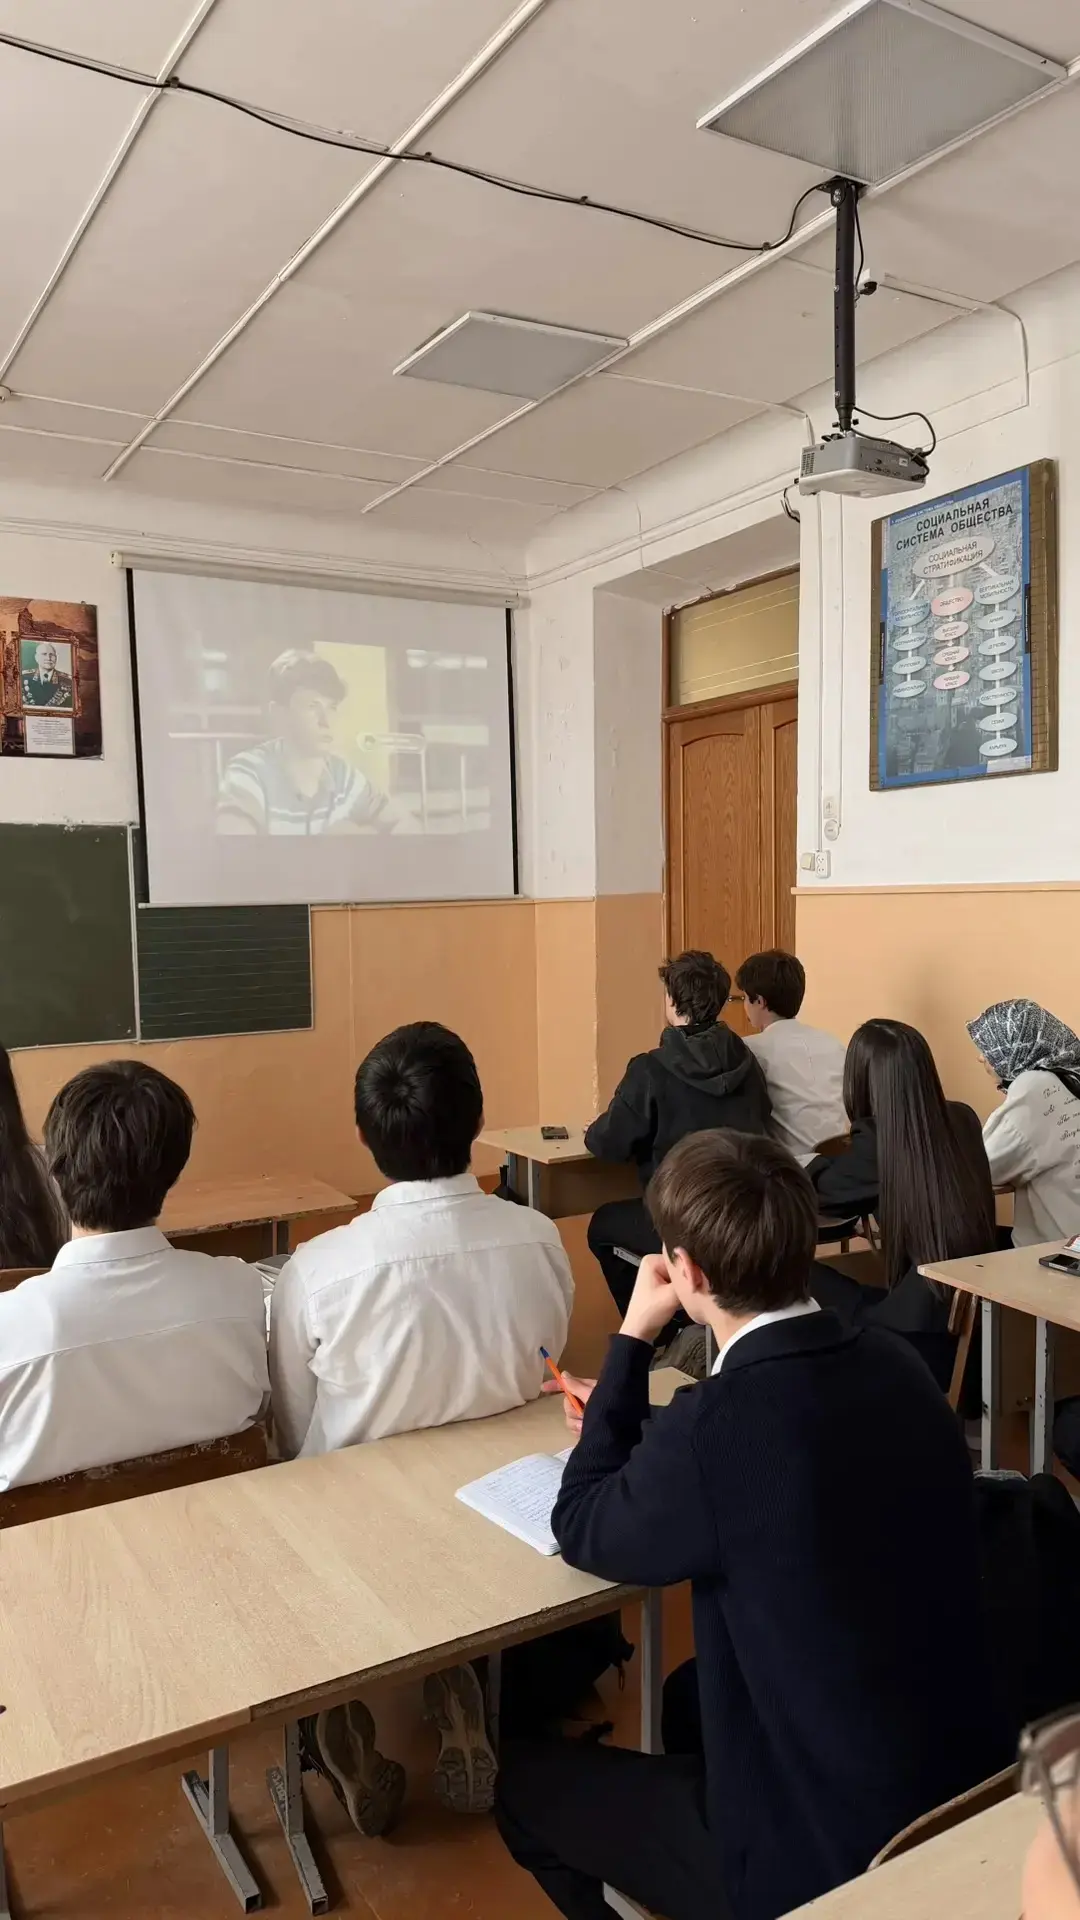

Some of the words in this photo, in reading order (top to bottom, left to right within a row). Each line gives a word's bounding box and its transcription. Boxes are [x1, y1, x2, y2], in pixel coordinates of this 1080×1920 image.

[896, 527, 945, 551] СИСТЕМА
[951, 504, 1013, 533] ОБЩЕСТВА
[916, 498, 989, 532] СОЦИАЛЬНАЯ
[923, 550, 984, 575] СТРАТИФИКАЦИЯ
[928, 541, 978, 563] СОЦИАЛЬНАЯ
